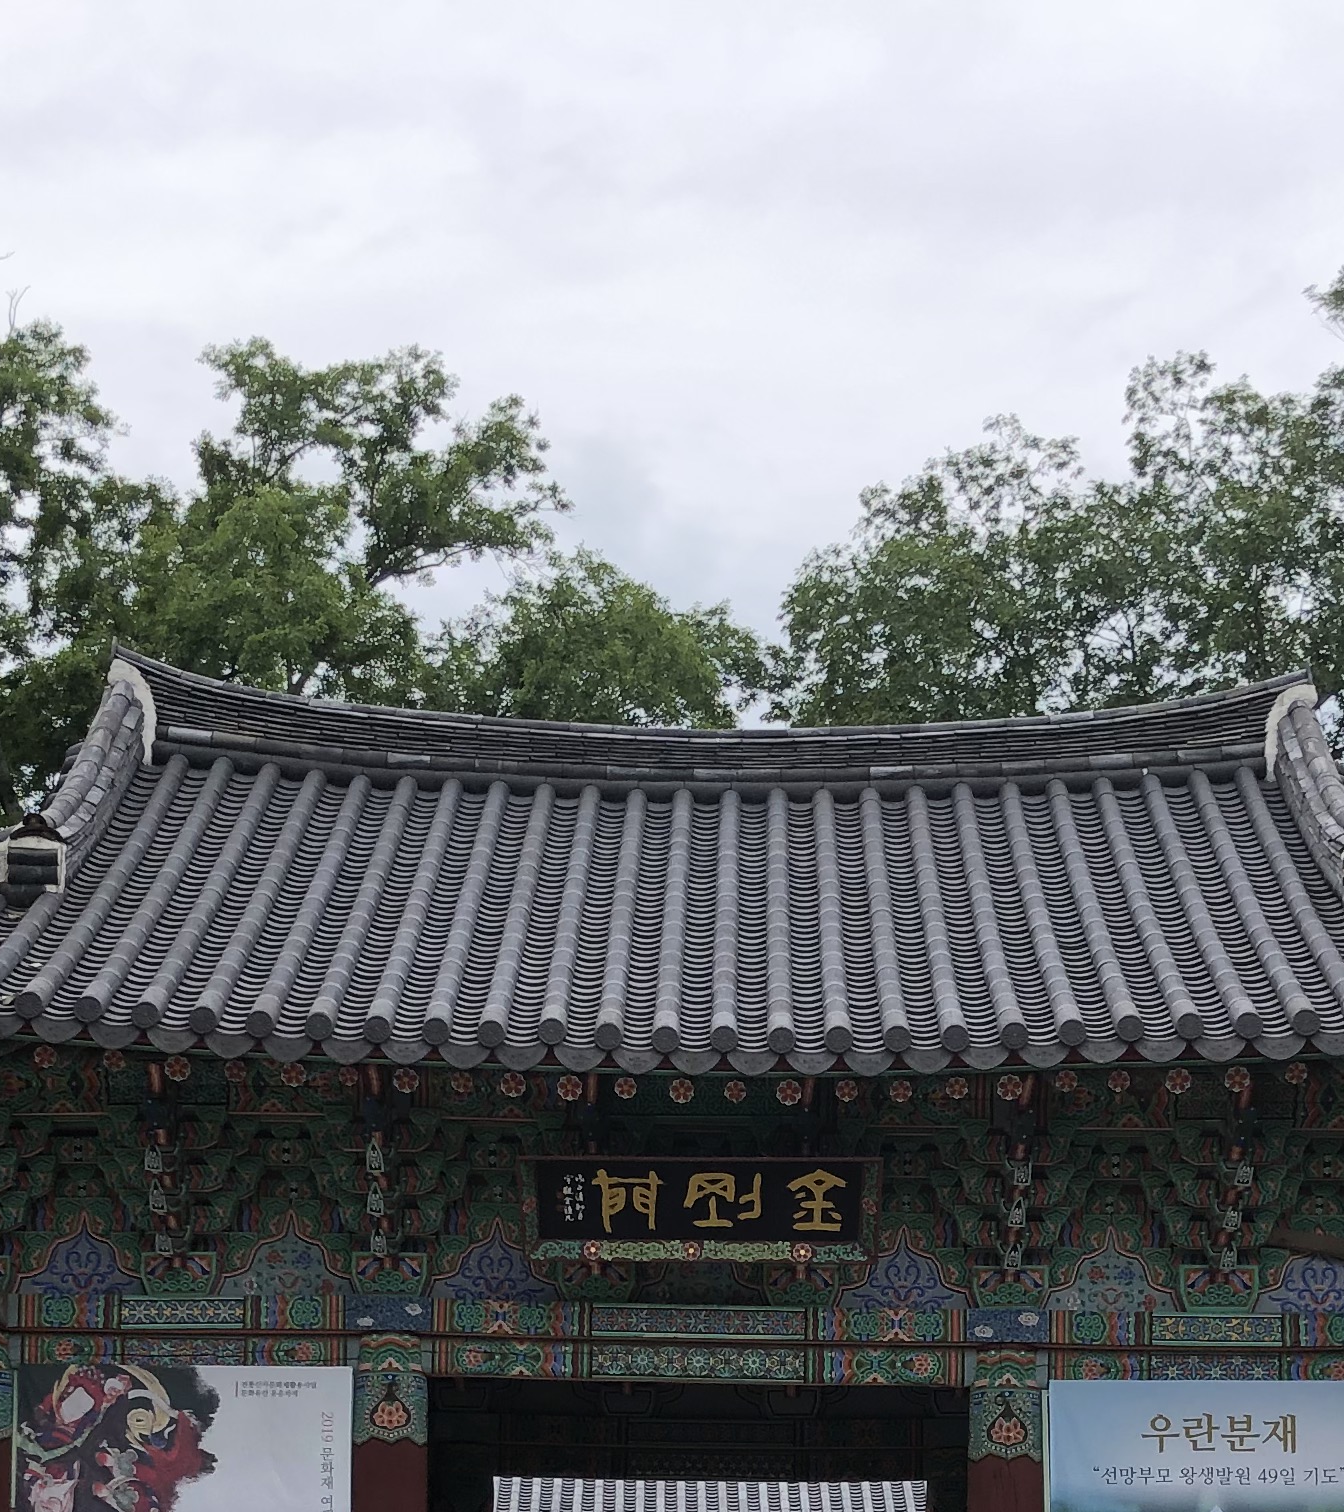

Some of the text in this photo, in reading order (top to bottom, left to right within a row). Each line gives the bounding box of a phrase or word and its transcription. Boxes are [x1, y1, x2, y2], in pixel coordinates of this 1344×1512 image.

[320, 1411, 334, 1442] 2019
[1141, 1412, 1297, 1453] 우란분재
[319, 1447, 334, 1490] 문화재
[1179, 1466, 1251, 1485] 왕생발원
[1257, 1467, 1296, 1485] 49일
